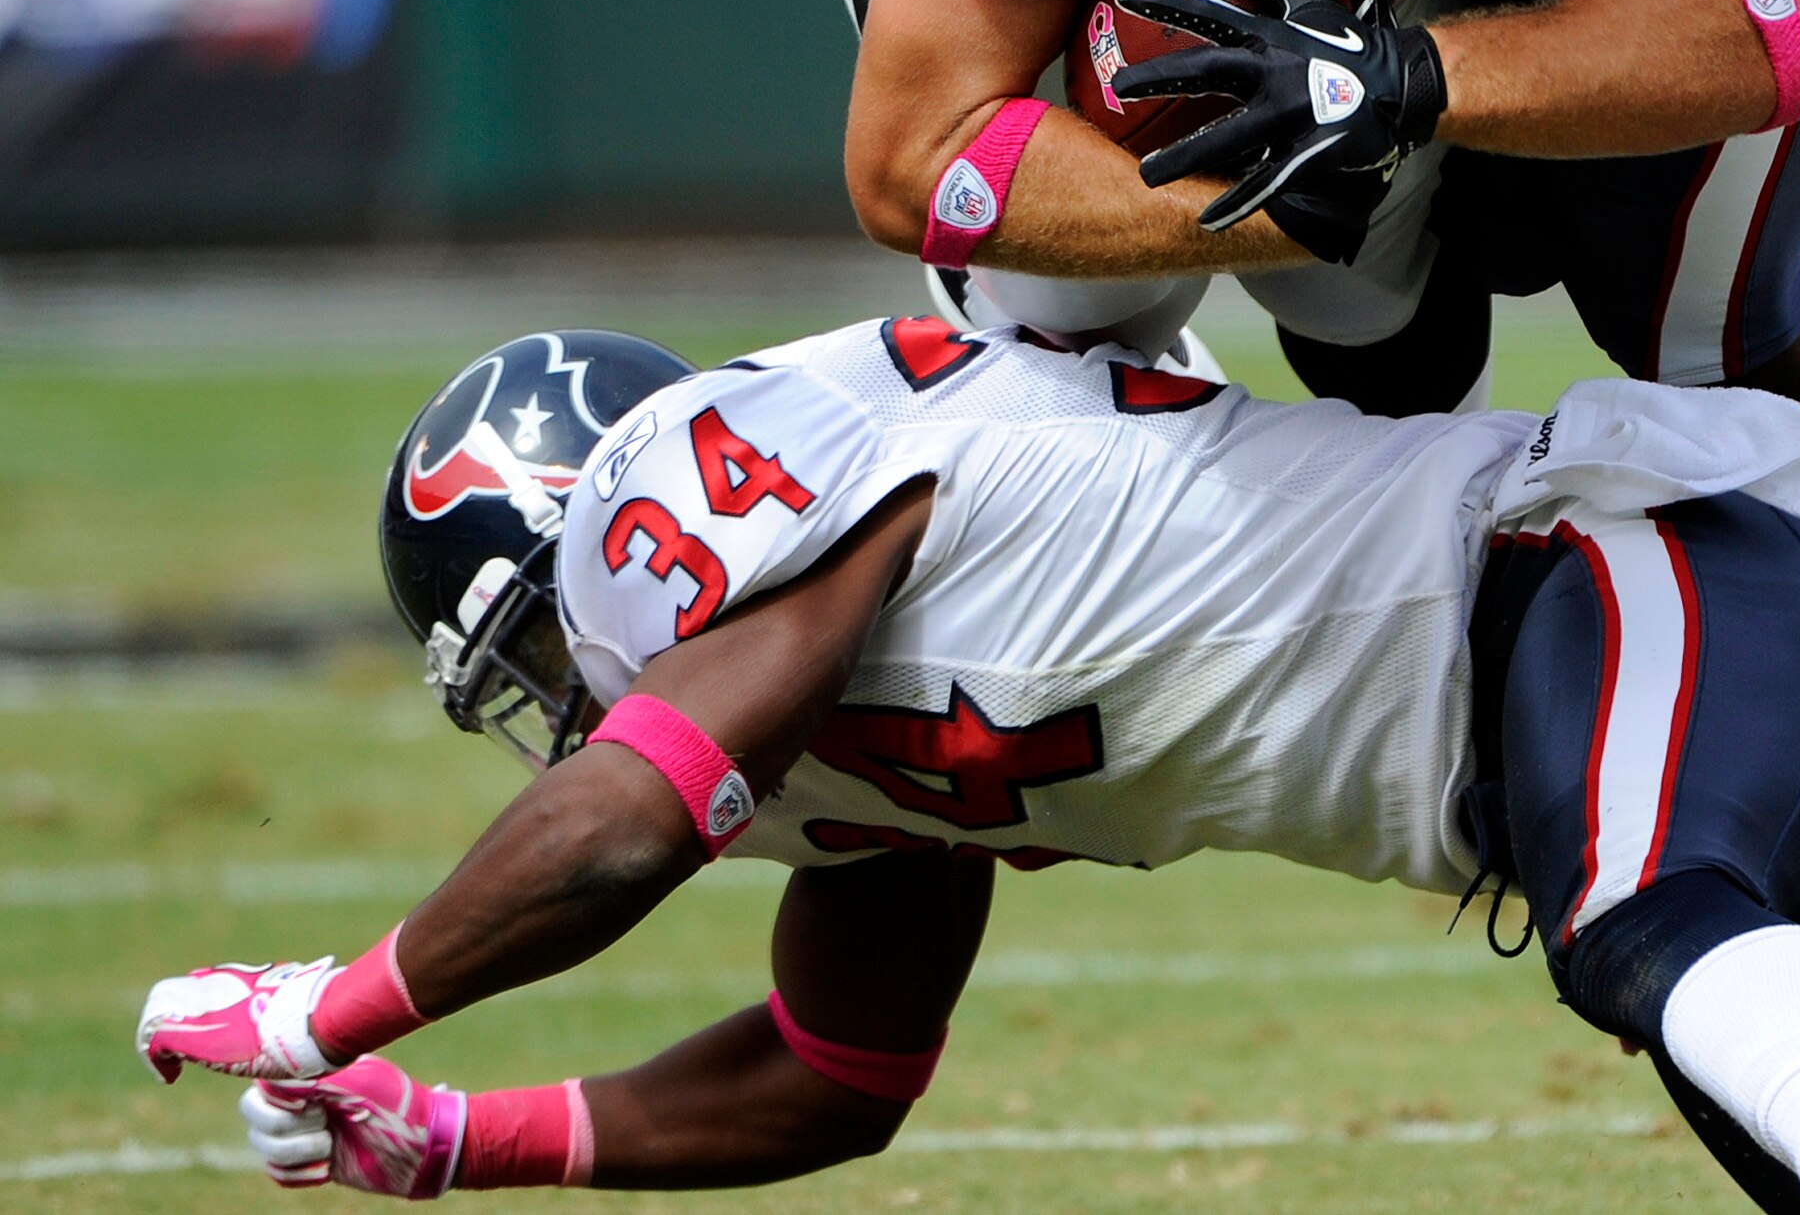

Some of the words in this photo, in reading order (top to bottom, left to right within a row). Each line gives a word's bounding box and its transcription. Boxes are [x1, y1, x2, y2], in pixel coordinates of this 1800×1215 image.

[1097, 49, 1123, 82] NFL
[1337, 80, 1351, 102] NFL
[942, 170, 967, 216] EQUIPMENT
[964, 196, 984, 219] NFL
[1524, 409, 1560, 486] ilson
[602, 404, 820, 642] 34
[714, 804, 731, 825] NFL
